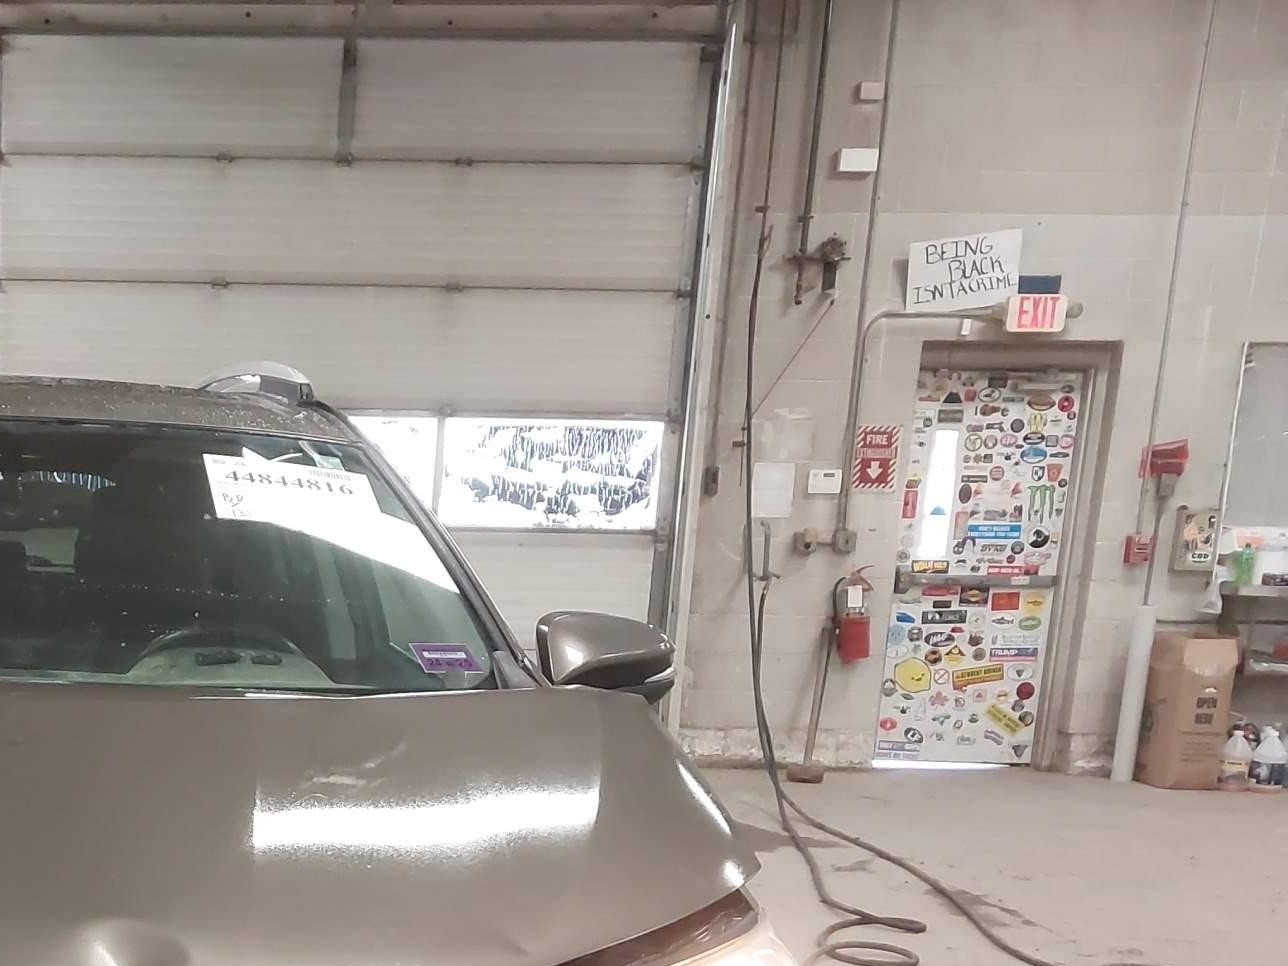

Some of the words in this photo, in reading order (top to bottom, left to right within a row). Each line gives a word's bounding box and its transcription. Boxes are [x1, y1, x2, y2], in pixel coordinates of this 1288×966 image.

[925, 237, 993, 264] BEING
[948, 256, 1004, 281] BLACK
[1017, 296, 1060, 329] EXIT
[866, 434, 889, 445] FIRE
[225, 470, 353, 495] 44844816
